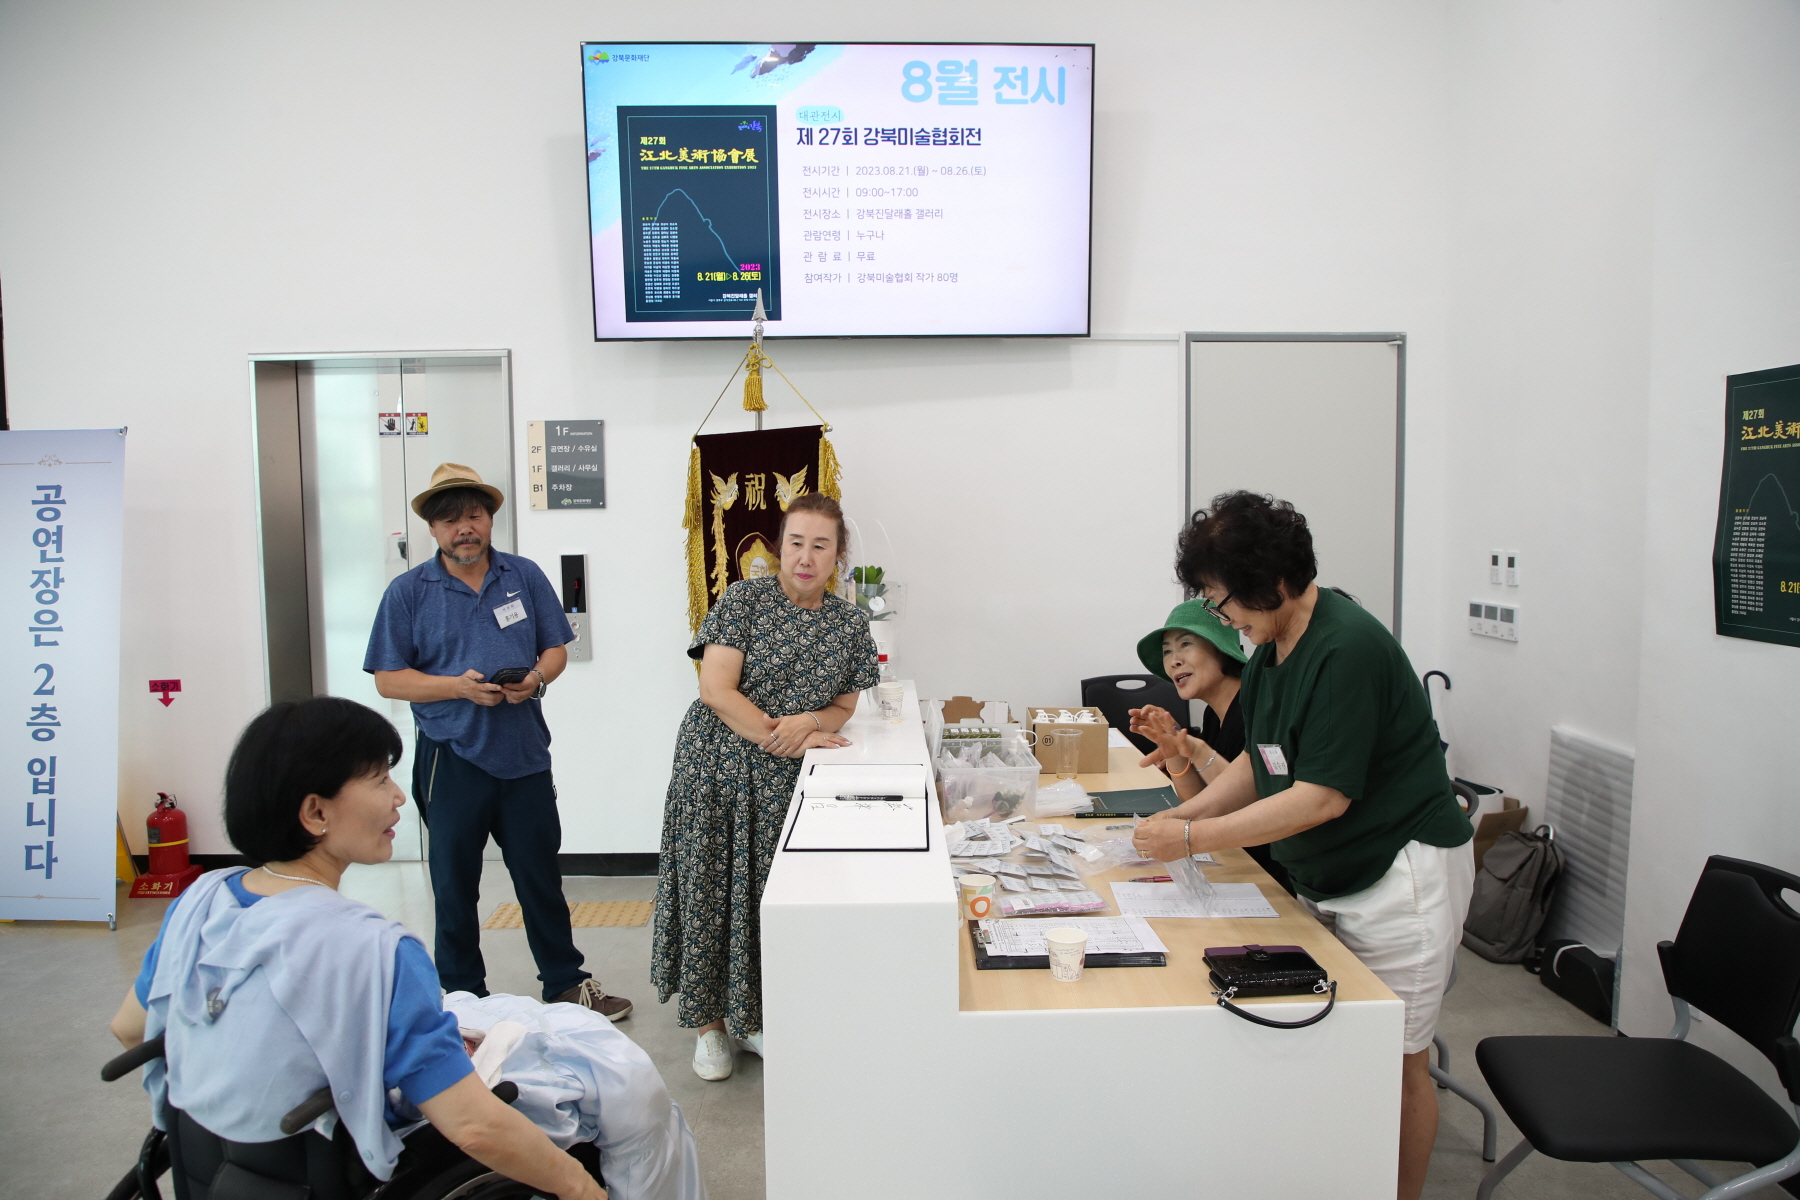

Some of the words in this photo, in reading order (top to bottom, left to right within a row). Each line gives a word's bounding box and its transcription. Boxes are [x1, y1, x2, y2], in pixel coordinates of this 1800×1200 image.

[612, 54, 650, 62] 강북문화재단
[901, 59, 979, 105] 8월
[993, 66, 1066, 105] 전시
[799, 110, 842, 122] 대관전시
[640, 136, 667, 145] 제27회
[796, 127, 814, 146] 제
[818, 127, 858, 146] 27회
[863, 127, 982, 146] 강북미술협회전
[639, 147, 759, 164] 江北美術協會展
[802, 166, 840, 176] 전시기간
[855, 166, 929, 177] 2023.08.21.(월)
[940, 166, 987, 177] 08.26.(토)
[802, 187, 840, 198] 전시시간
[855, 187, 918, 197] 09:00~17:00
[802, 208, 841, 220] 전시장소
[856, 208, 912, 220] 강북진달래홀
[916, 208, 943, 220] 갤러리
[803, 230, 841, 241] 관람연령
[856, 230, 885, 241] 누구나
[856, 252, 875, 262] 무료
[804, 273, 842, 283] 참여작가
[857, 272, 913, 283] 강북미술협회
[916, 272, 934, 282] 작가
[937, 272, 958, 283] 80명
[1742, 408, 1765, 420] 제27회
[556, 426, 569, 436] 1F
[550, 445, 570, 453] 공연장
[532, 465, 542, 473] 1F
[551, 464, 570, 472] 갤러리
[578, 464, 598, 472] 사무실
[533, 484, 543, 492] B1
[551, 484, 572, 492] 주차장
[744, 472, 766, 510] 祝
[28, 484, 67, 648] 공연장은
[152, 681, 179, 692] 소화기
[24, 755, 59, 880] 입니다
[138, 882, 174, 891] 소화기
